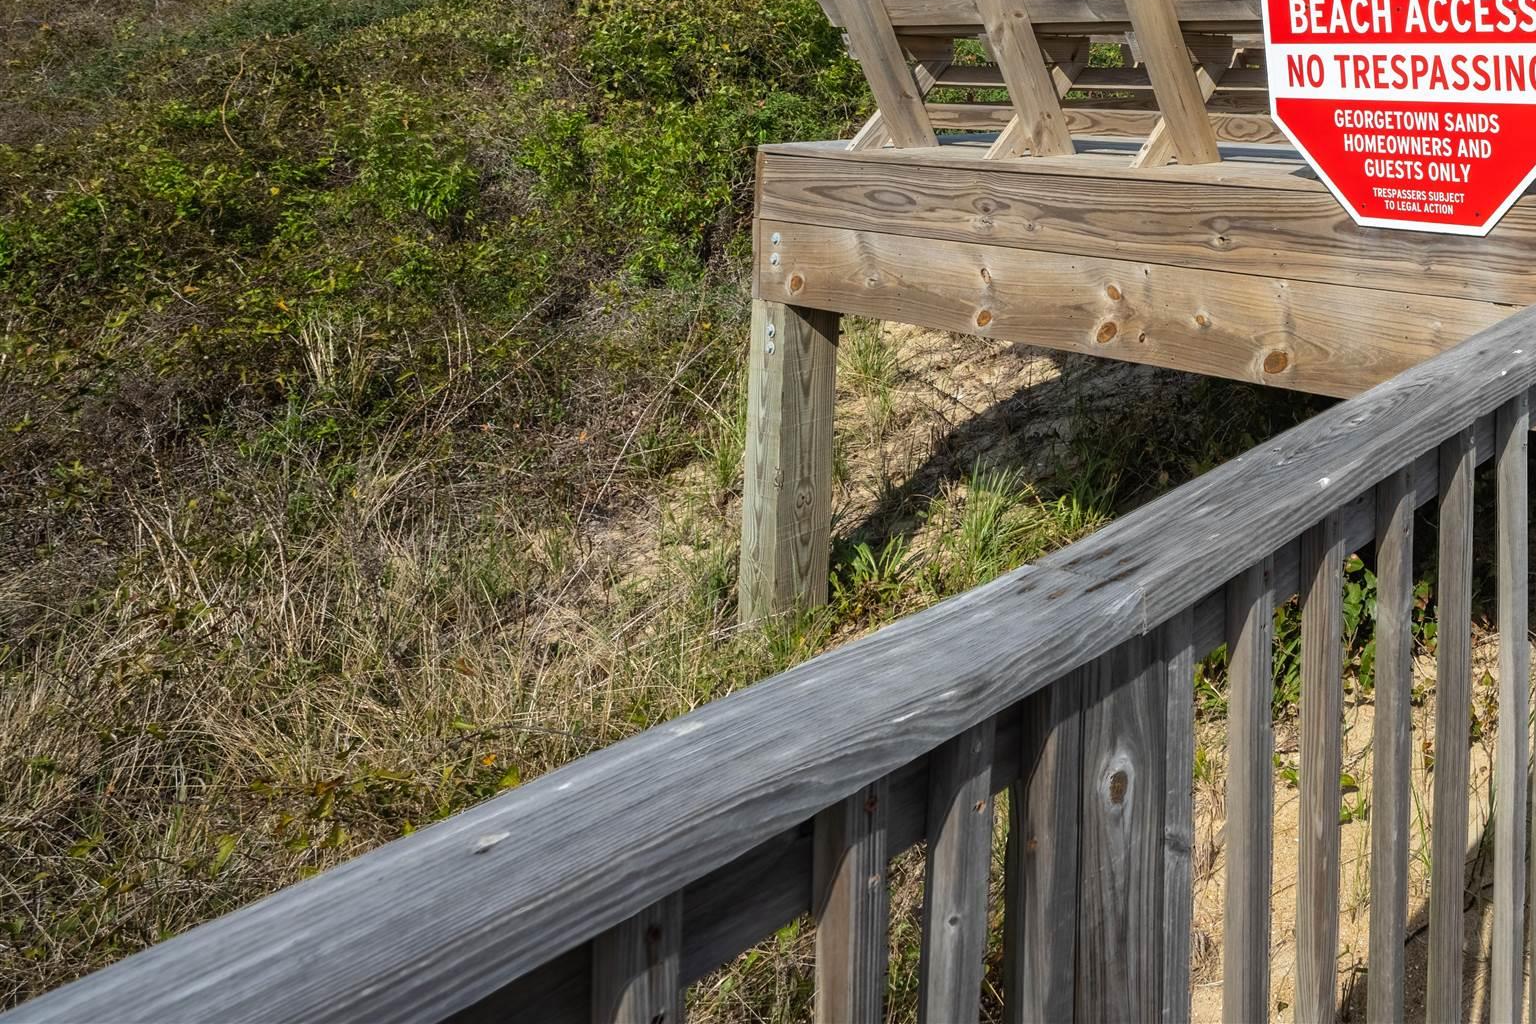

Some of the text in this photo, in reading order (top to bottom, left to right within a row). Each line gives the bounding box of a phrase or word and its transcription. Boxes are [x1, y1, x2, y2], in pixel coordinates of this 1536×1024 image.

[1287, 54, 1324, 88] NO
[1334, 109, 1499, 133] GEORGETOWN SANDS
[1344, 134, 1491, 158] HOMEOWNERS AND
[1365, 159, 1470, 182] GUESTS ONLY
[1373, 188, 1464, 204] TRESPASSERS SUBJECT
[1385, 200, 1454, 214] TO LEGAL ACTION
